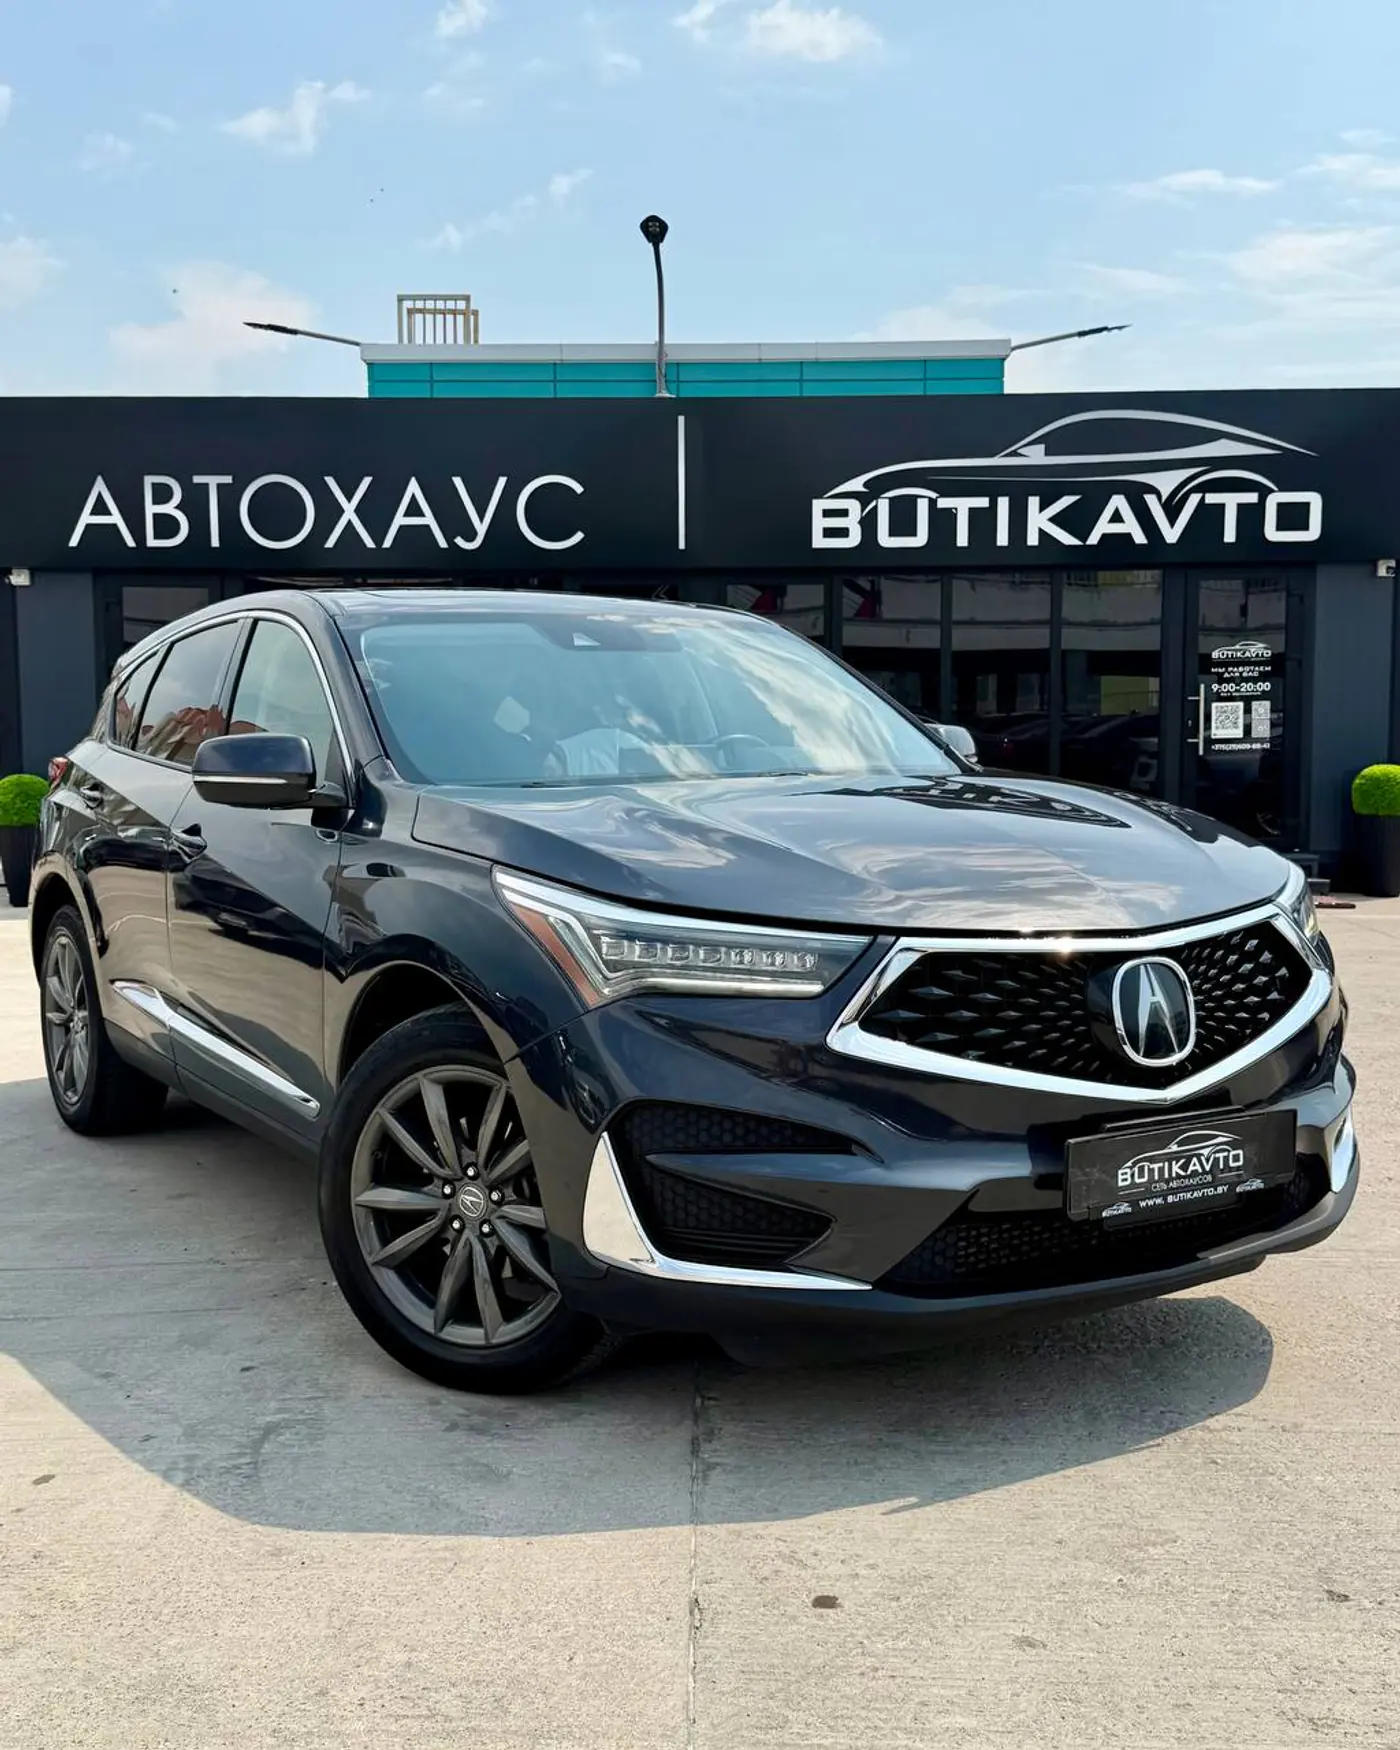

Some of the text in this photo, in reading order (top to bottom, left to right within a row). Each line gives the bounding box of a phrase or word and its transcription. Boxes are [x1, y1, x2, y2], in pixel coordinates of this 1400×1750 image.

[68, 473, 586, 551] АВТОХАУС
[811, 490, 1323, 549] BUTIKAVTO
[1211, 650, 1272, 659] BUTIKAVTO
[1211, 681, 1272, 693] 9:00-20:00
[1117, 1149, 1244, 1187] BUTIKAVTO
[1151, 1181, 1167, 1192] СЕТЬ
[1167, 1185, 1229, 1203] BUTIKAVTO.BY
